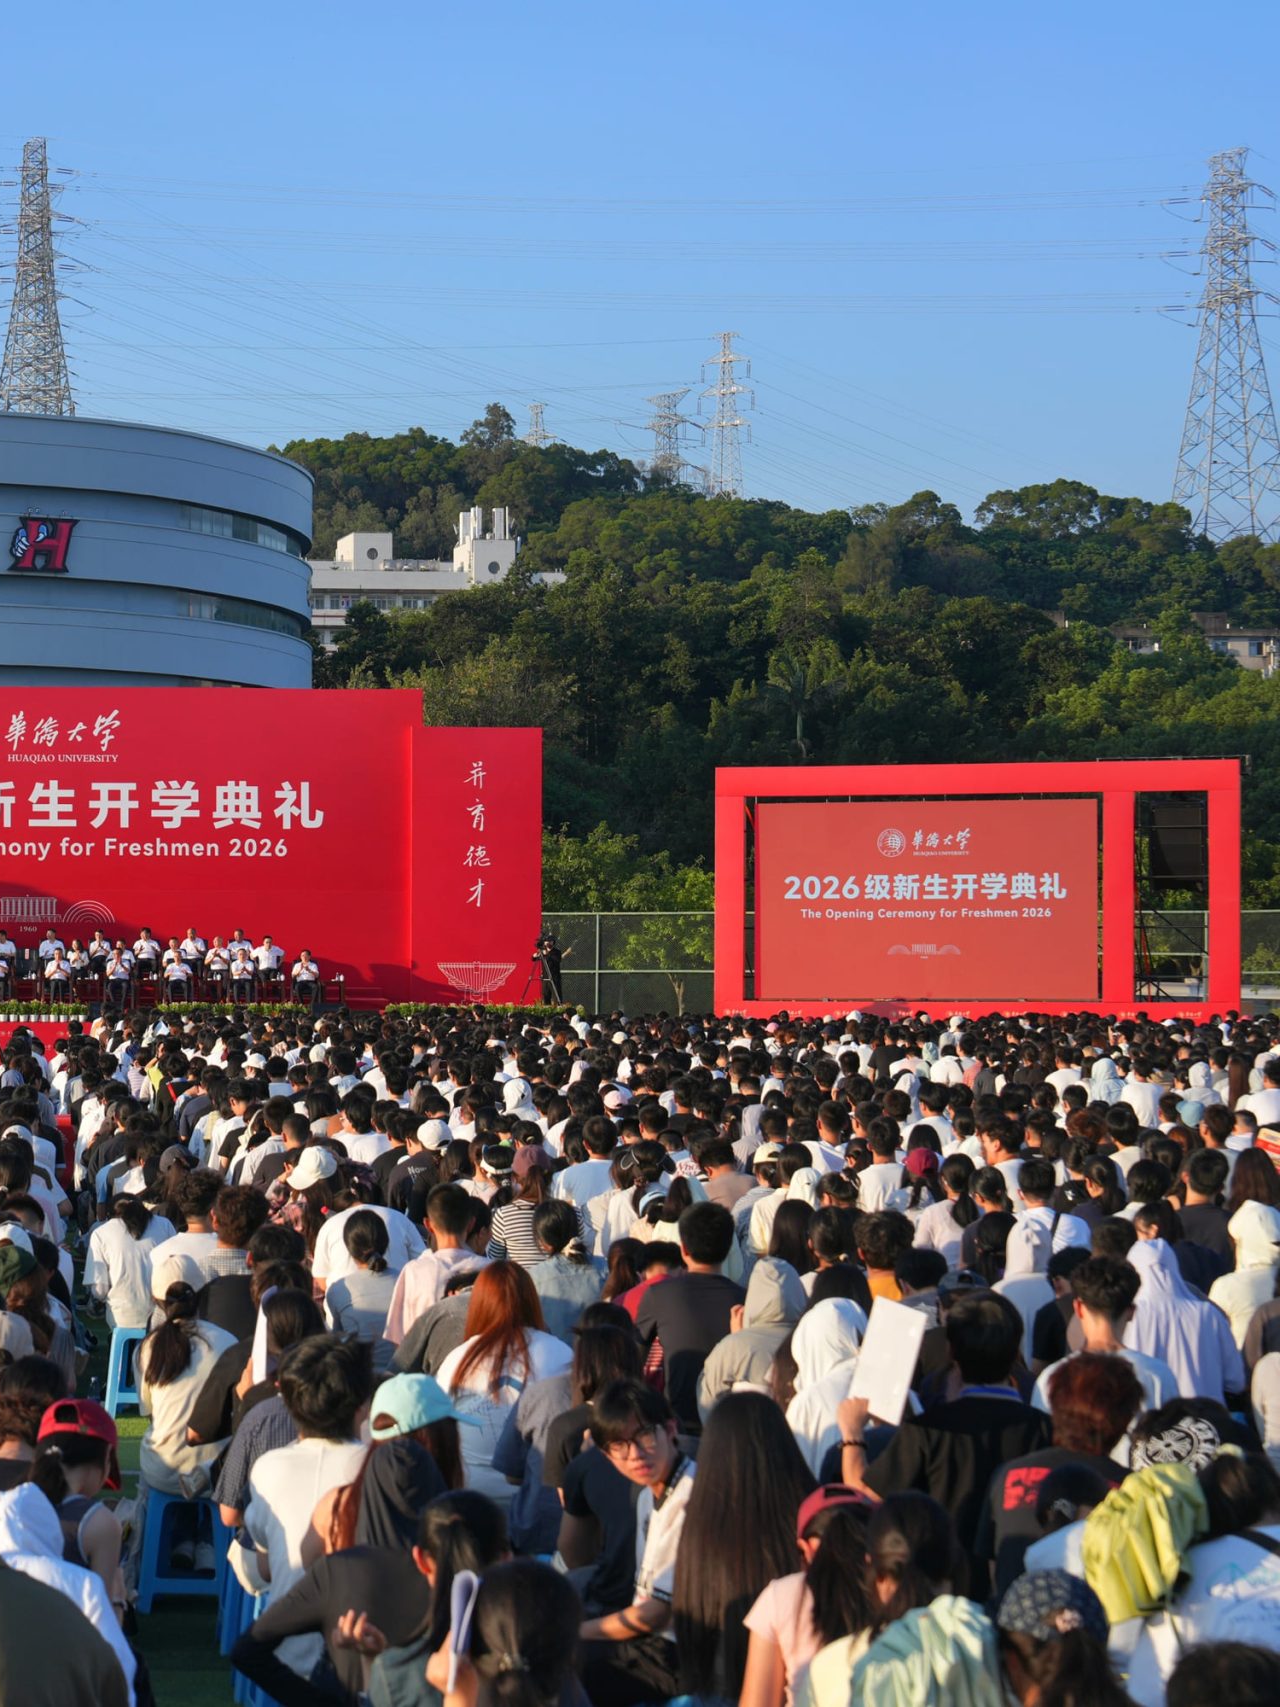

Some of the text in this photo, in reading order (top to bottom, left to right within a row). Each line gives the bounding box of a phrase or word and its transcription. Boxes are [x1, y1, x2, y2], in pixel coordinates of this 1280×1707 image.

[7, 754, 119, 765] HUAQIAO UNIVERSITY
[60, 837, 96, 857] for
[104, 837, 220, 857] Freshmen
[229, 838, 288, 857] 2026
[784, 872, 1067, 900] 2026级新生开学典礼
[800, 907, 1052, 921] The Opening Ceremony for Freshmen 2026
